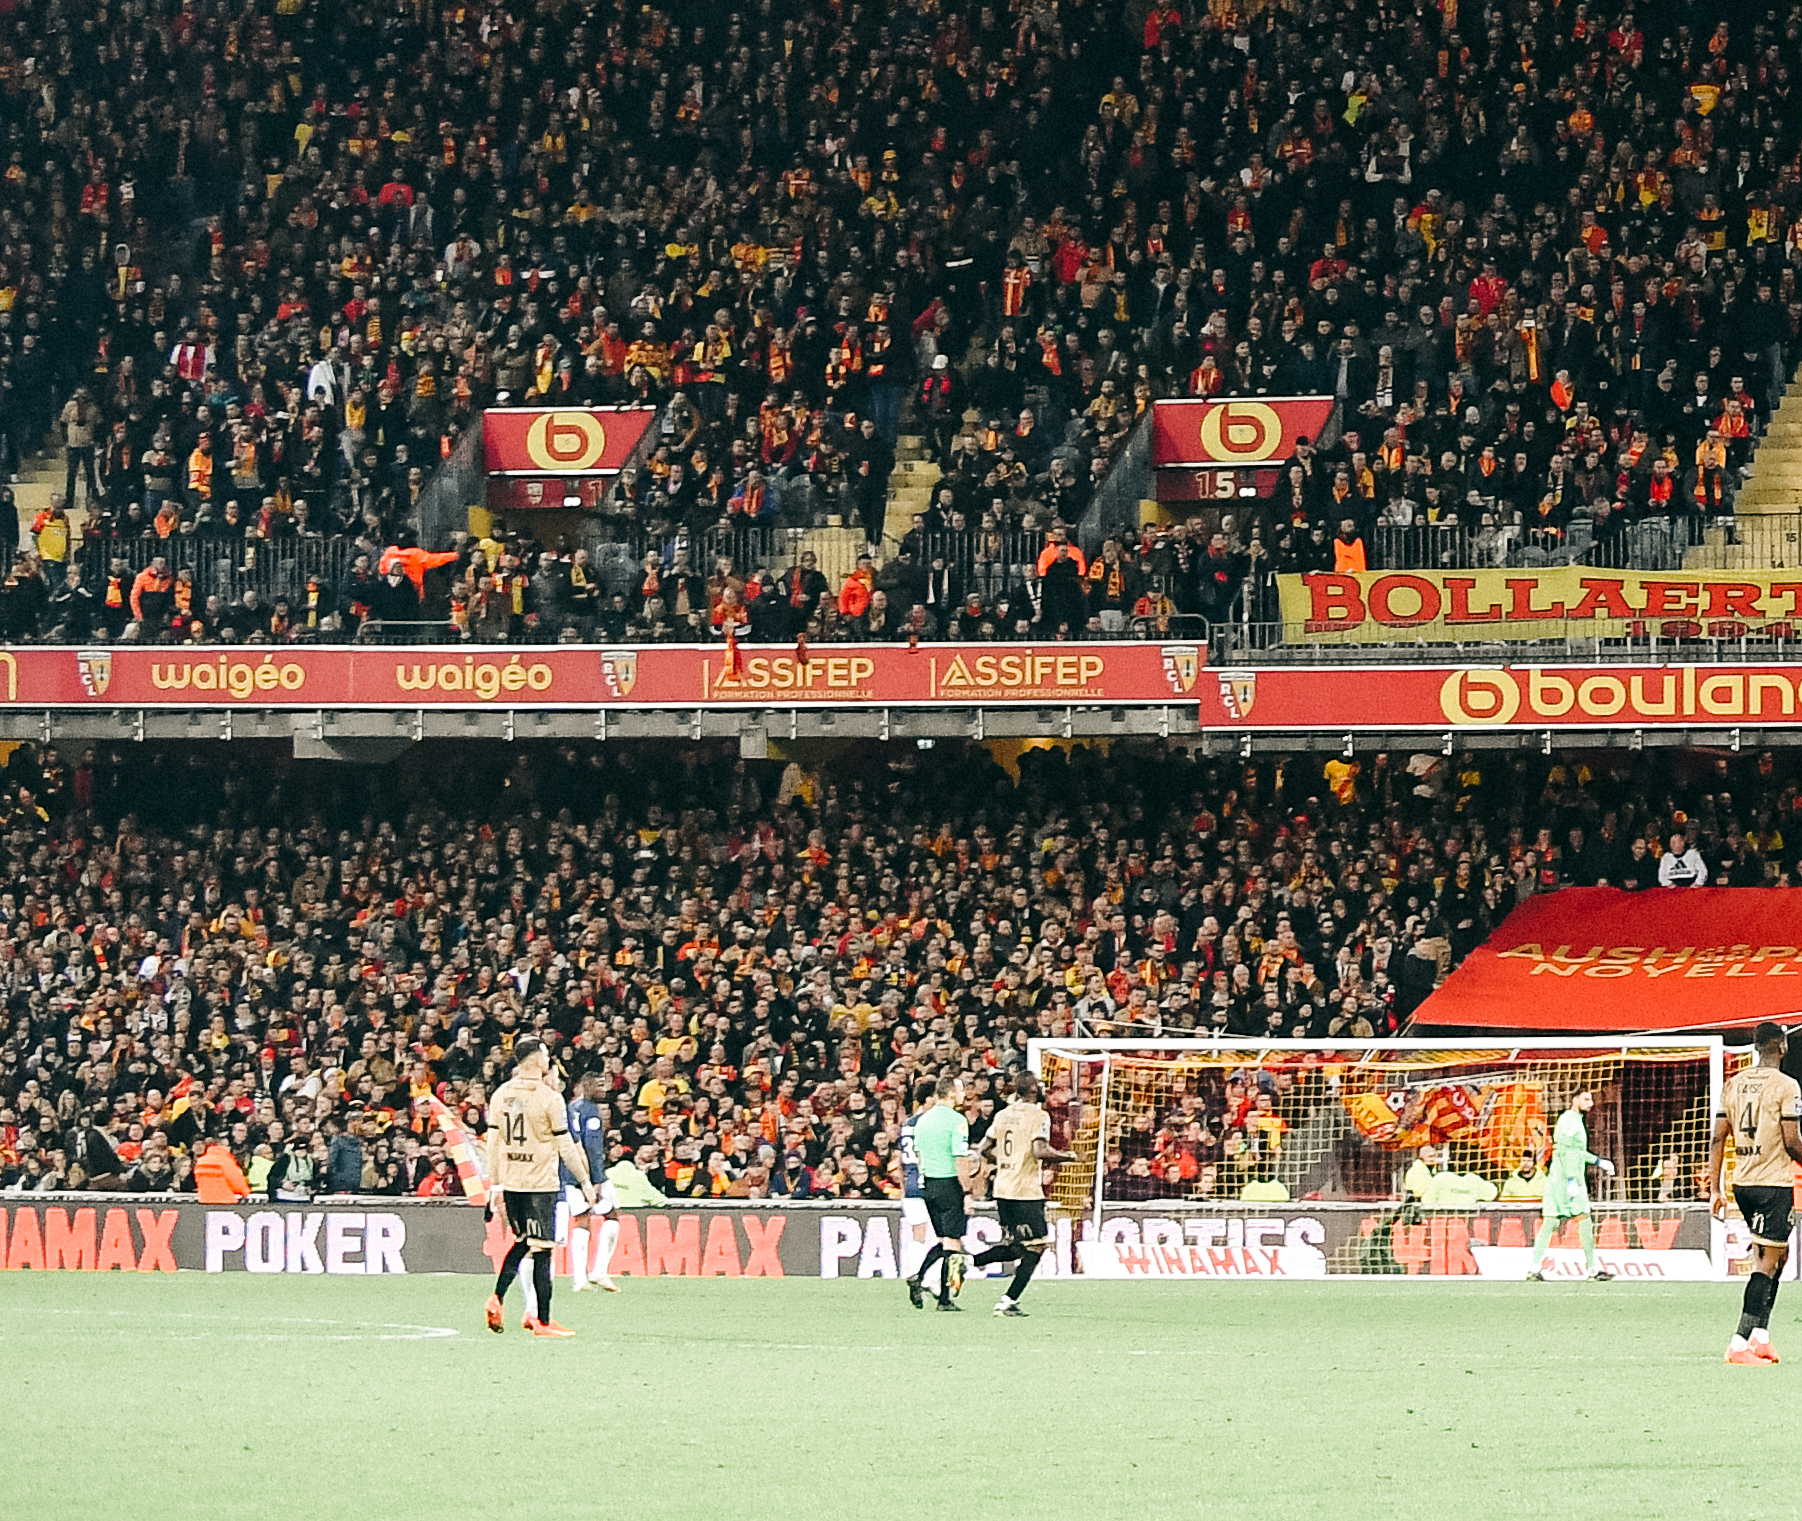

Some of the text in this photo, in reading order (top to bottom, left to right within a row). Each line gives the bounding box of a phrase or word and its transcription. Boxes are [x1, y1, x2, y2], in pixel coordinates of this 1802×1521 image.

[1196, 470, 1235, 499] 1.5
[151, 654, 306, 699] waigéo
[396, 654, 552, 699] waigéo
[503, 1111, 527, 1147] 14
[1739, 1102, 1757, 1139] 4
[0, 1206, 407, 1273] AMAX POKER
[1115, 1244, 1288, 1275] WINAMAX
